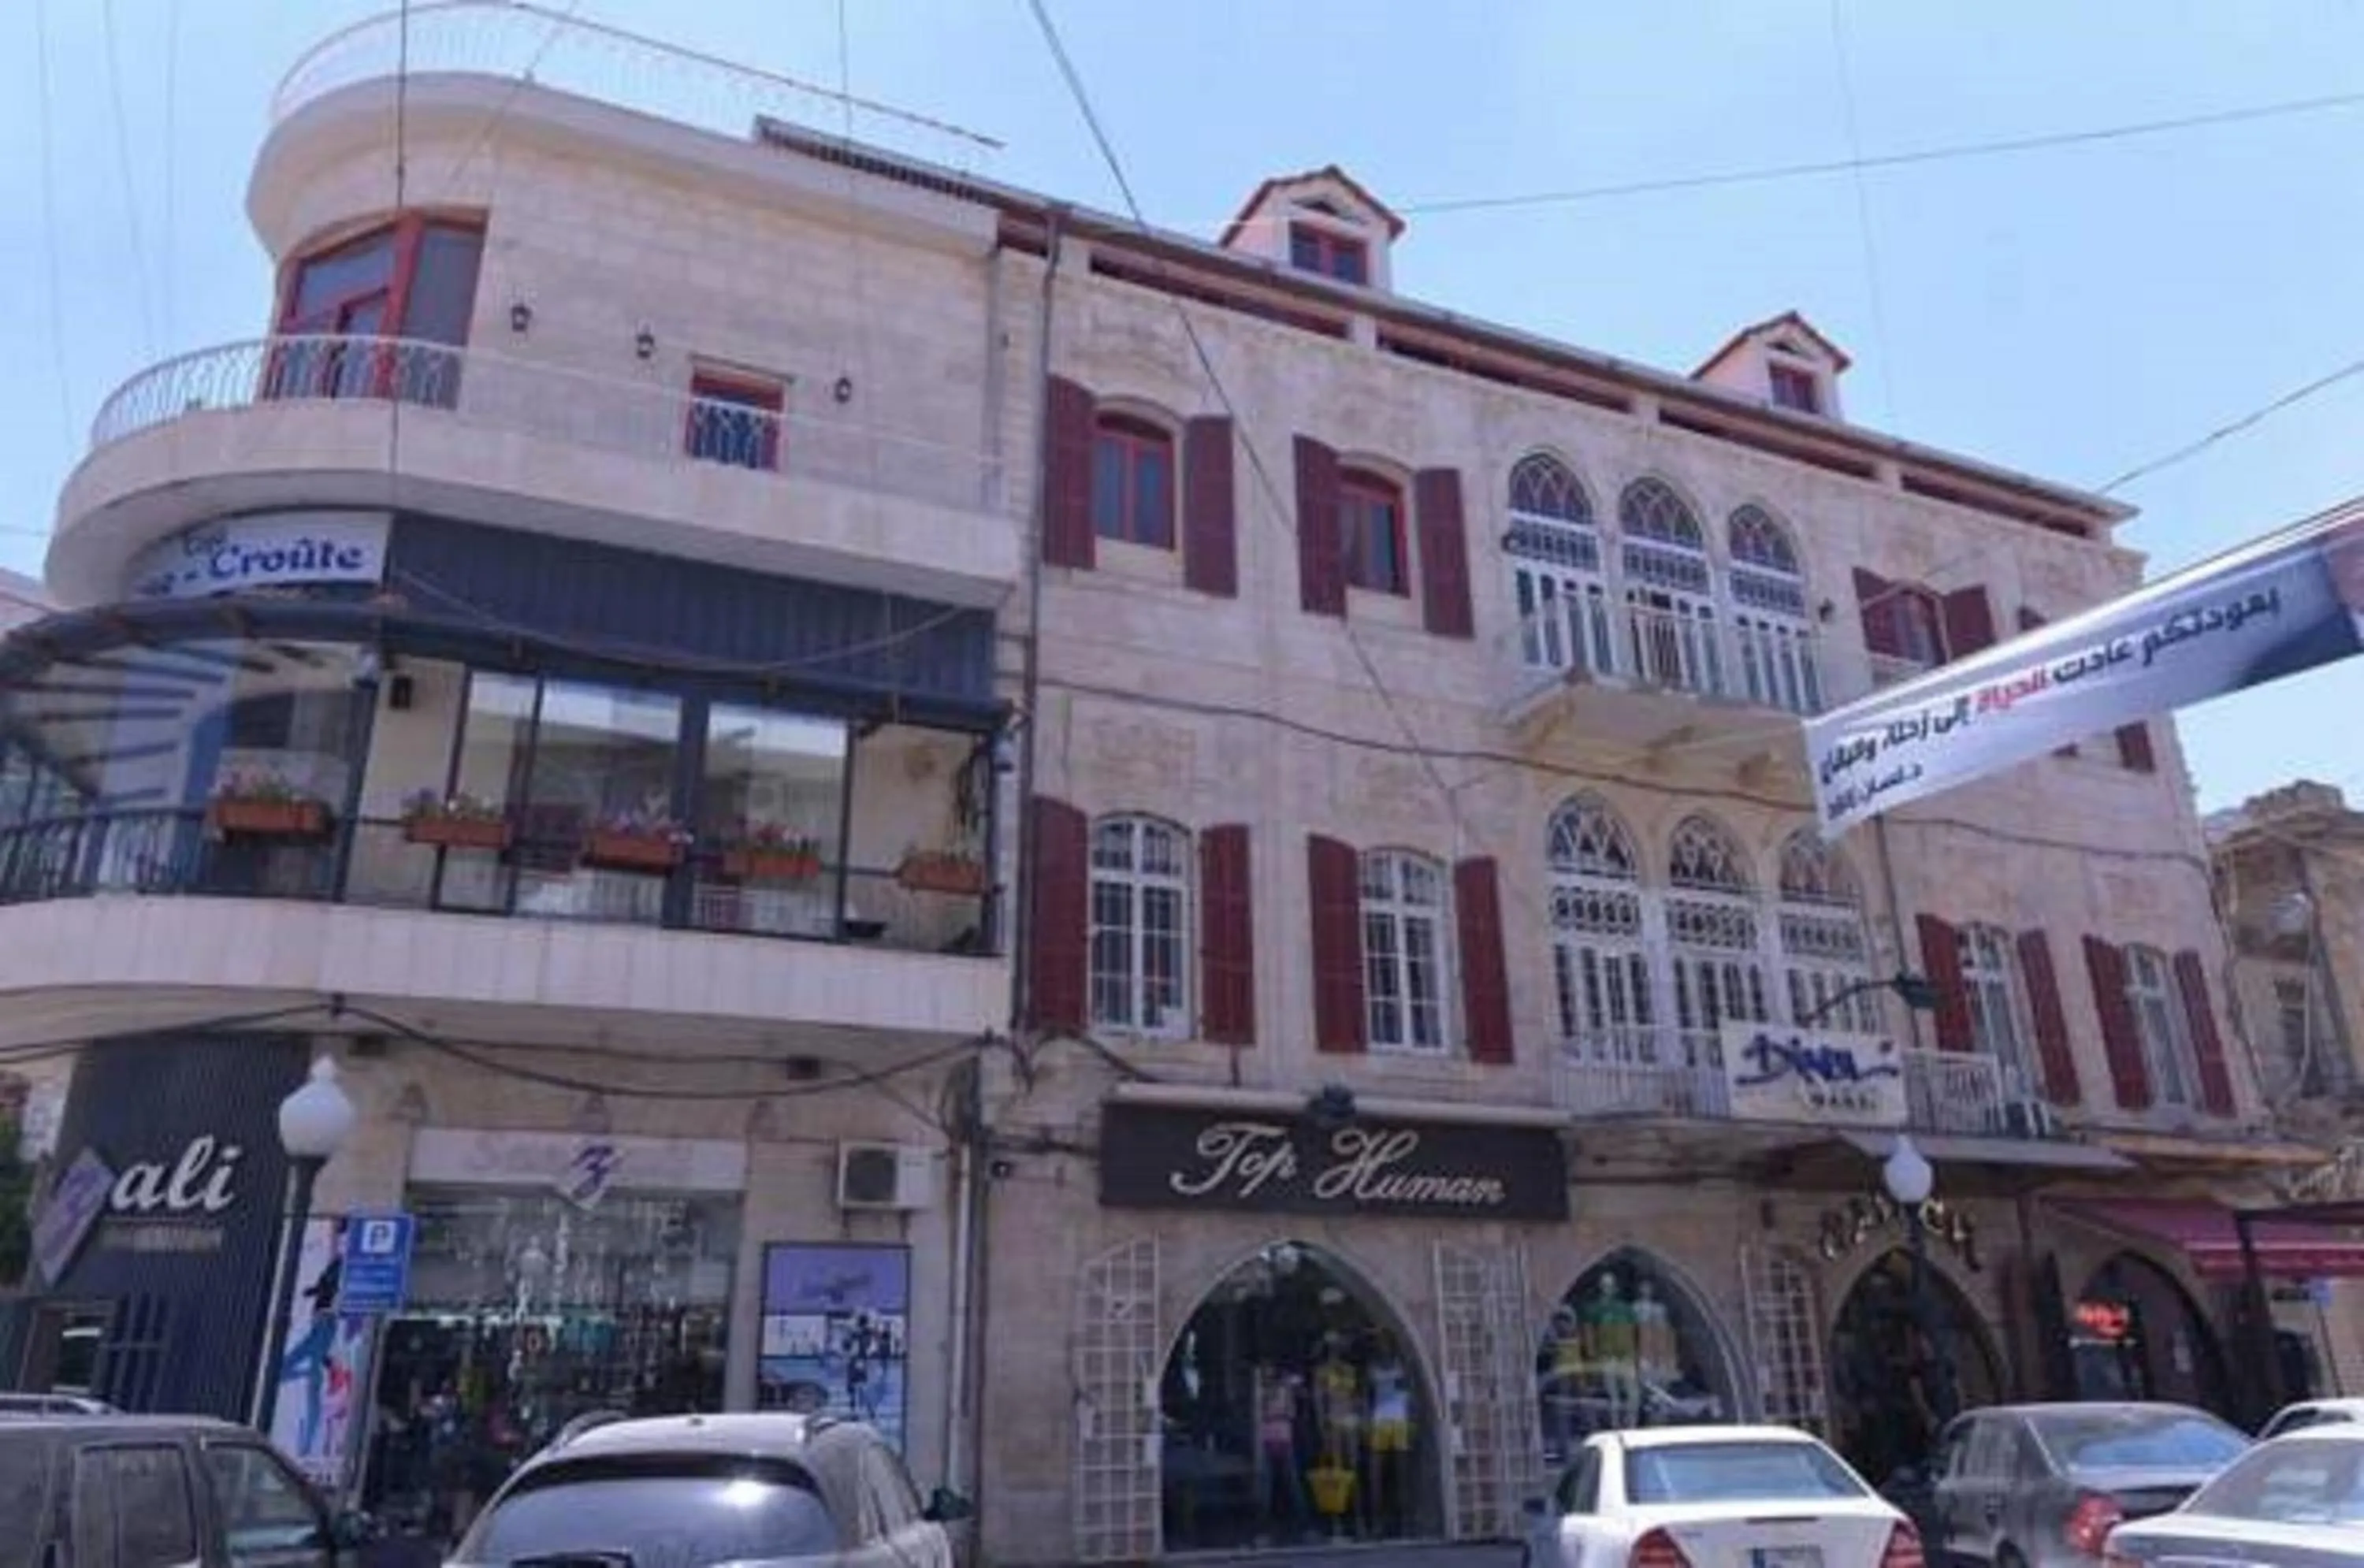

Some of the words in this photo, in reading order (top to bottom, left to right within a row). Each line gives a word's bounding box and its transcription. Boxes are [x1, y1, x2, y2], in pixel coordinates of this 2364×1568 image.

[2052, 640, 2134, 684] عادت
[1169, 1122, 1298, 1196] Top
[1314, 1128, 1507, 1205] Human
